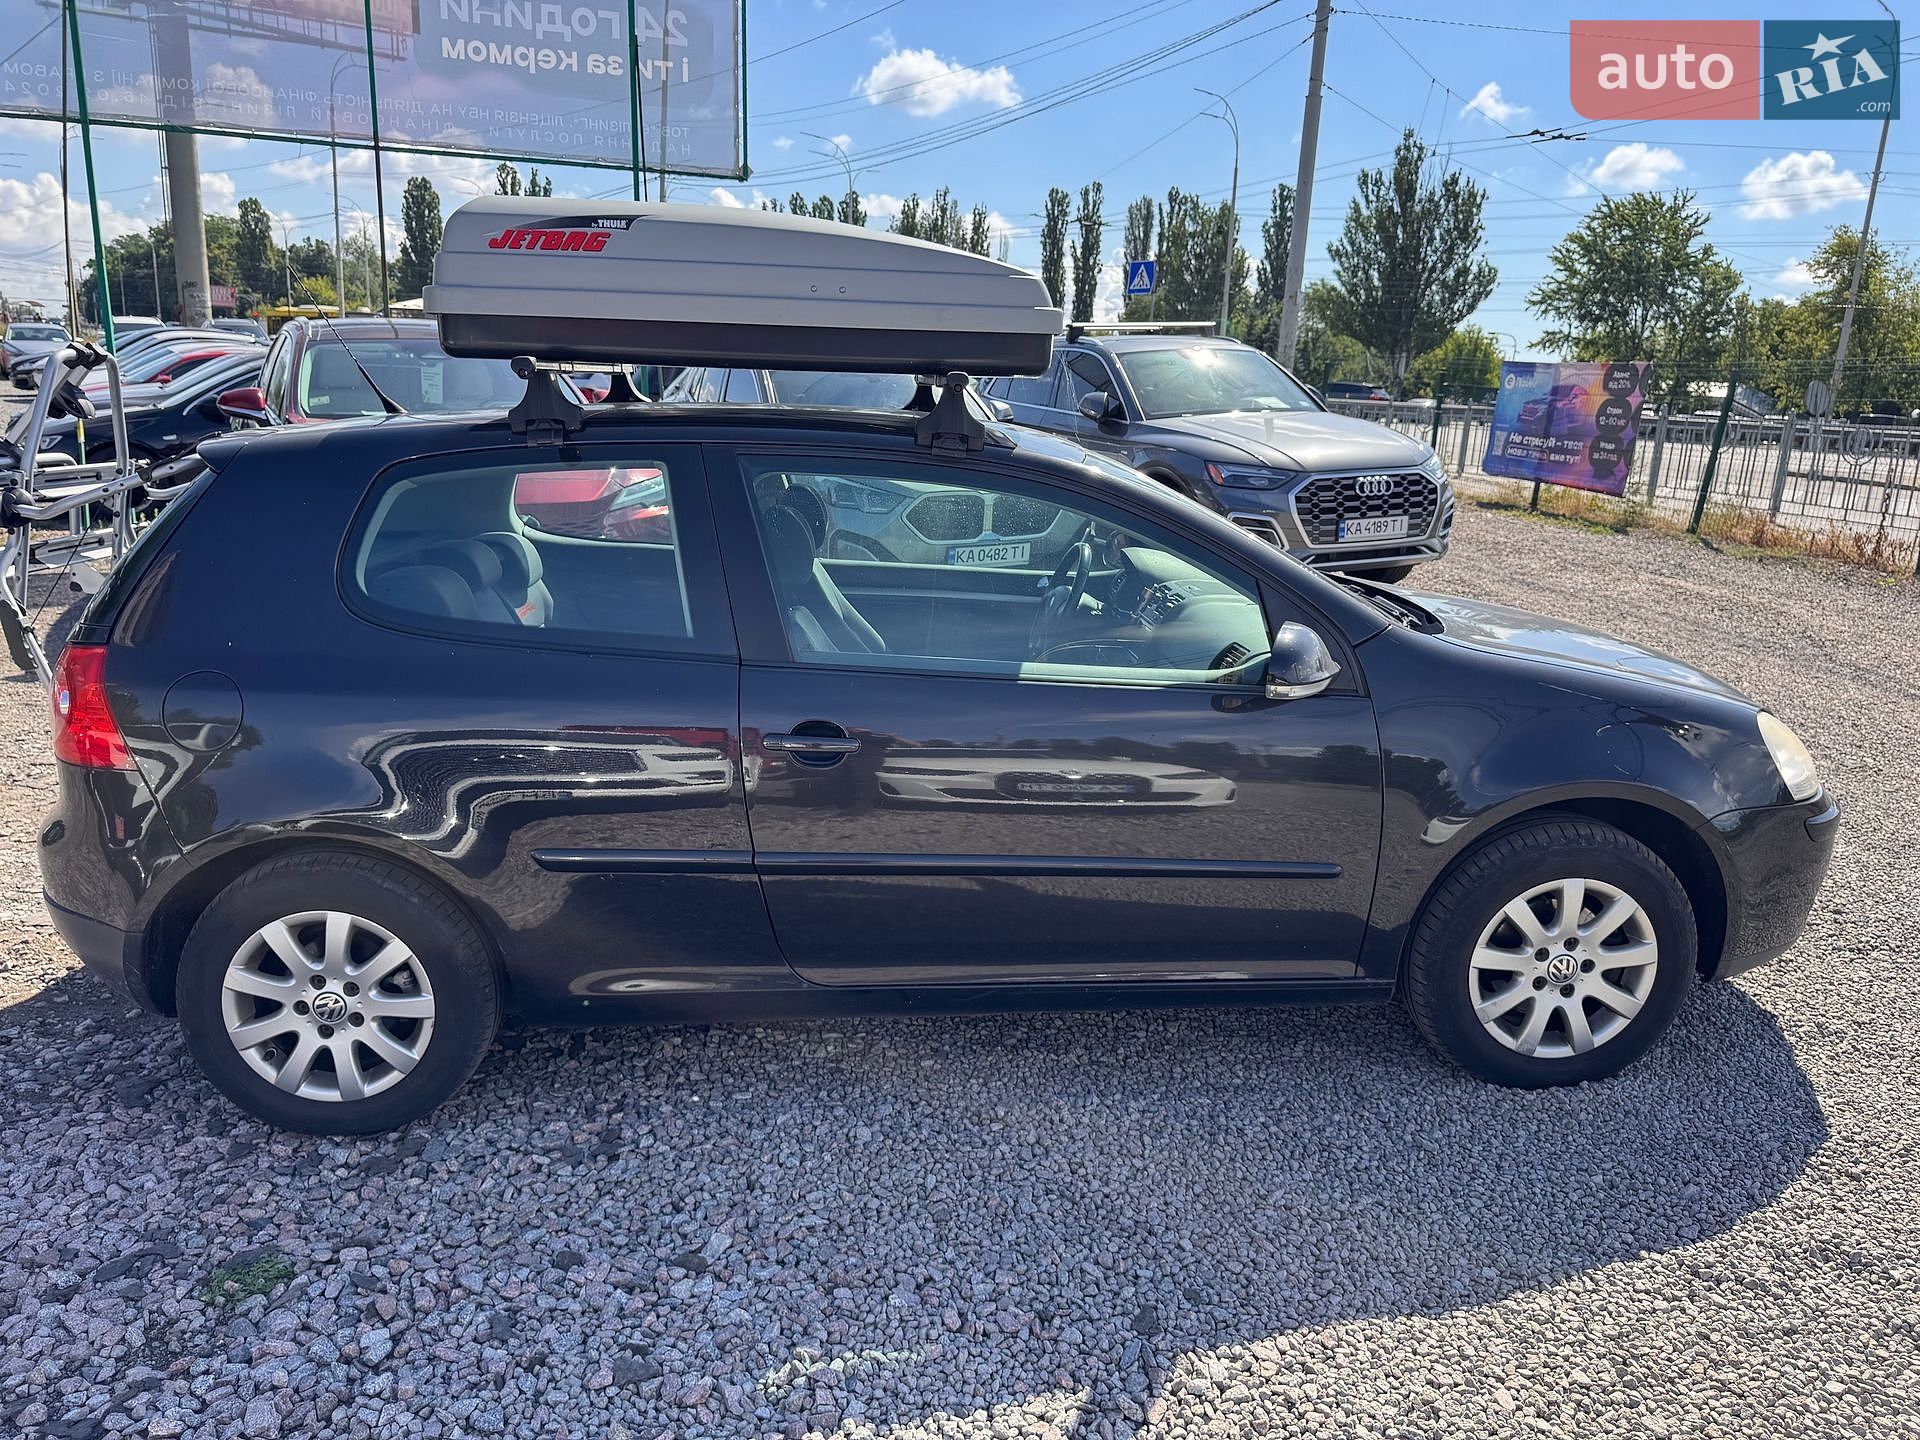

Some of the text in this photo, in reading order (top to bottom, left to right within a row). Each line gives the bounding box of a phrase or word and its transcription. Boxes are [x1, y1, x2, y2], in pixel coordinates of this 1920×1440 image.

[598, 219, 627, 228] THULE
[489, 229, 611, 251] JETBAG
[1509, 431, 1523, 443] Не
[1346, 519, 1403, 536] KA 4189 TI
[956, 546, 1025, 563] KA 0482 TI
